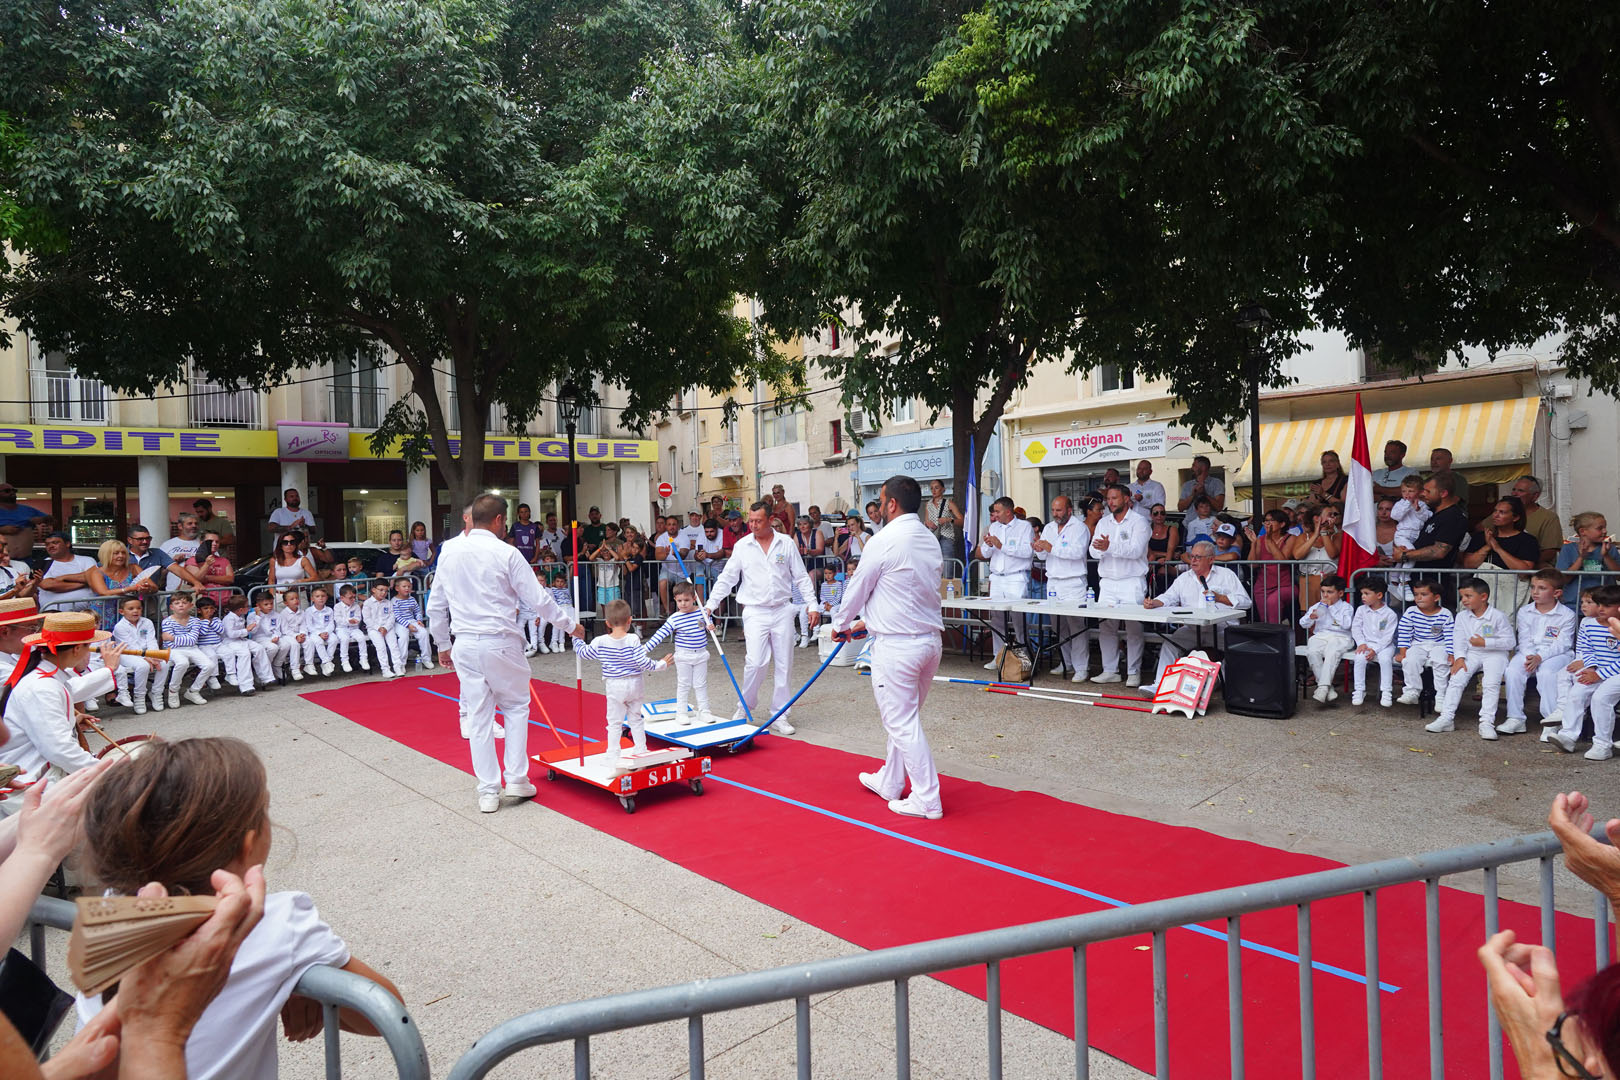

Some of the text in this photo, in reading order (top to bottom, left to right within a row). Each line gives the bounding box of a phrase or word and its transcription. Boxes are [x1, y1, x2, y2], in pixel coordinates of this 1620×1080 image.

[1054, 433, 1123, 449] Frontignan
[1137, 438, 1163, 446] LOCATION
[1061, 447, 1088, 456] immo
[1099, 450, 1120, 459] agence
[904, 456, 942, 472] apogée
